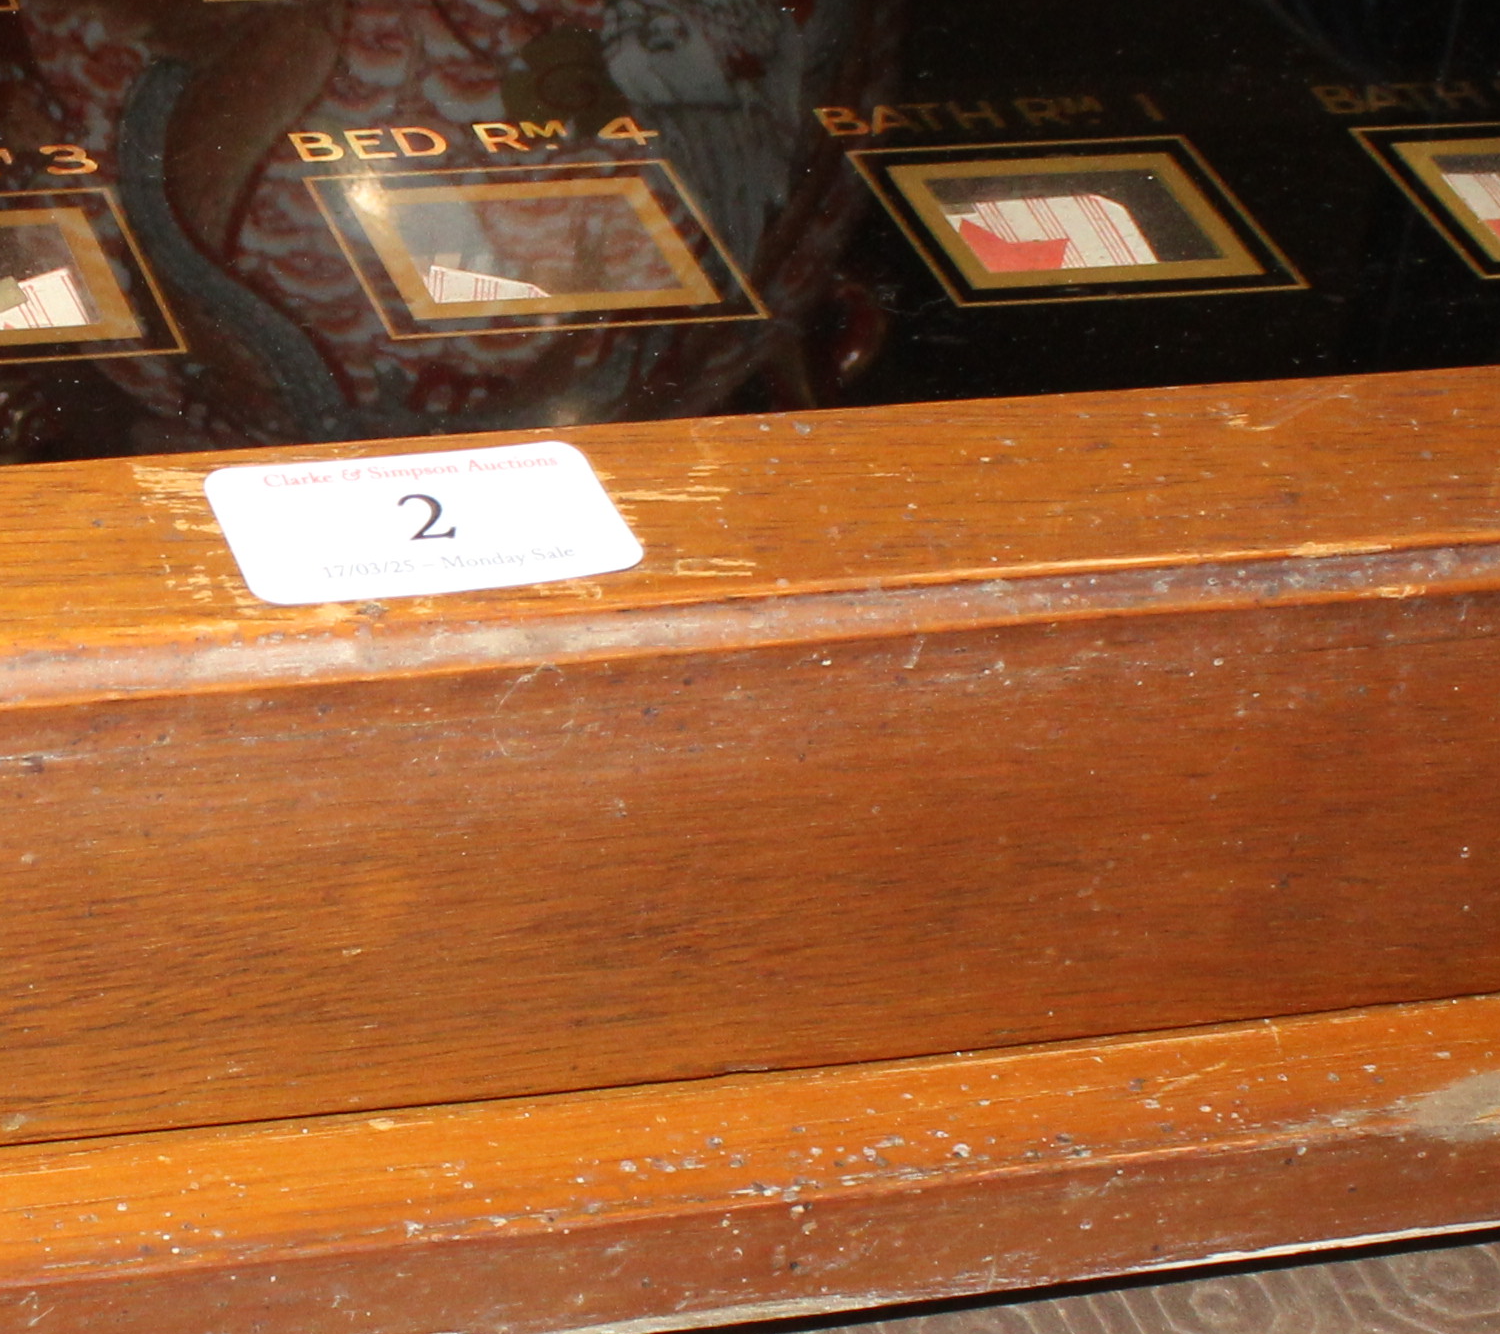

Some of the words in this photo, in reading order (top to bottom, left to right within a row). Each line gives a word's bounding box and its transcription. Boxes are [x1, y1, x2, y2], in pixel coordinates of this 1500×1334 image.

[811, 99, 1006, 137] BATH
[287, 126, 448, 164] BED
[596, 115, 660, 146] 4
[38, 143, 99, 177] 3
[262, 470, 334, 490] Clarke
[340, 466, 364, 484] &
[368, 461, 460, 485] Simpson
[467, 453, 559, 475] Auctions
[396, 492, 458, 542] 2
[322, 558, 416, 580] 17/03/25
[440, 551, 526, 572] Monday
[532, 544, 577, 562] Sale
